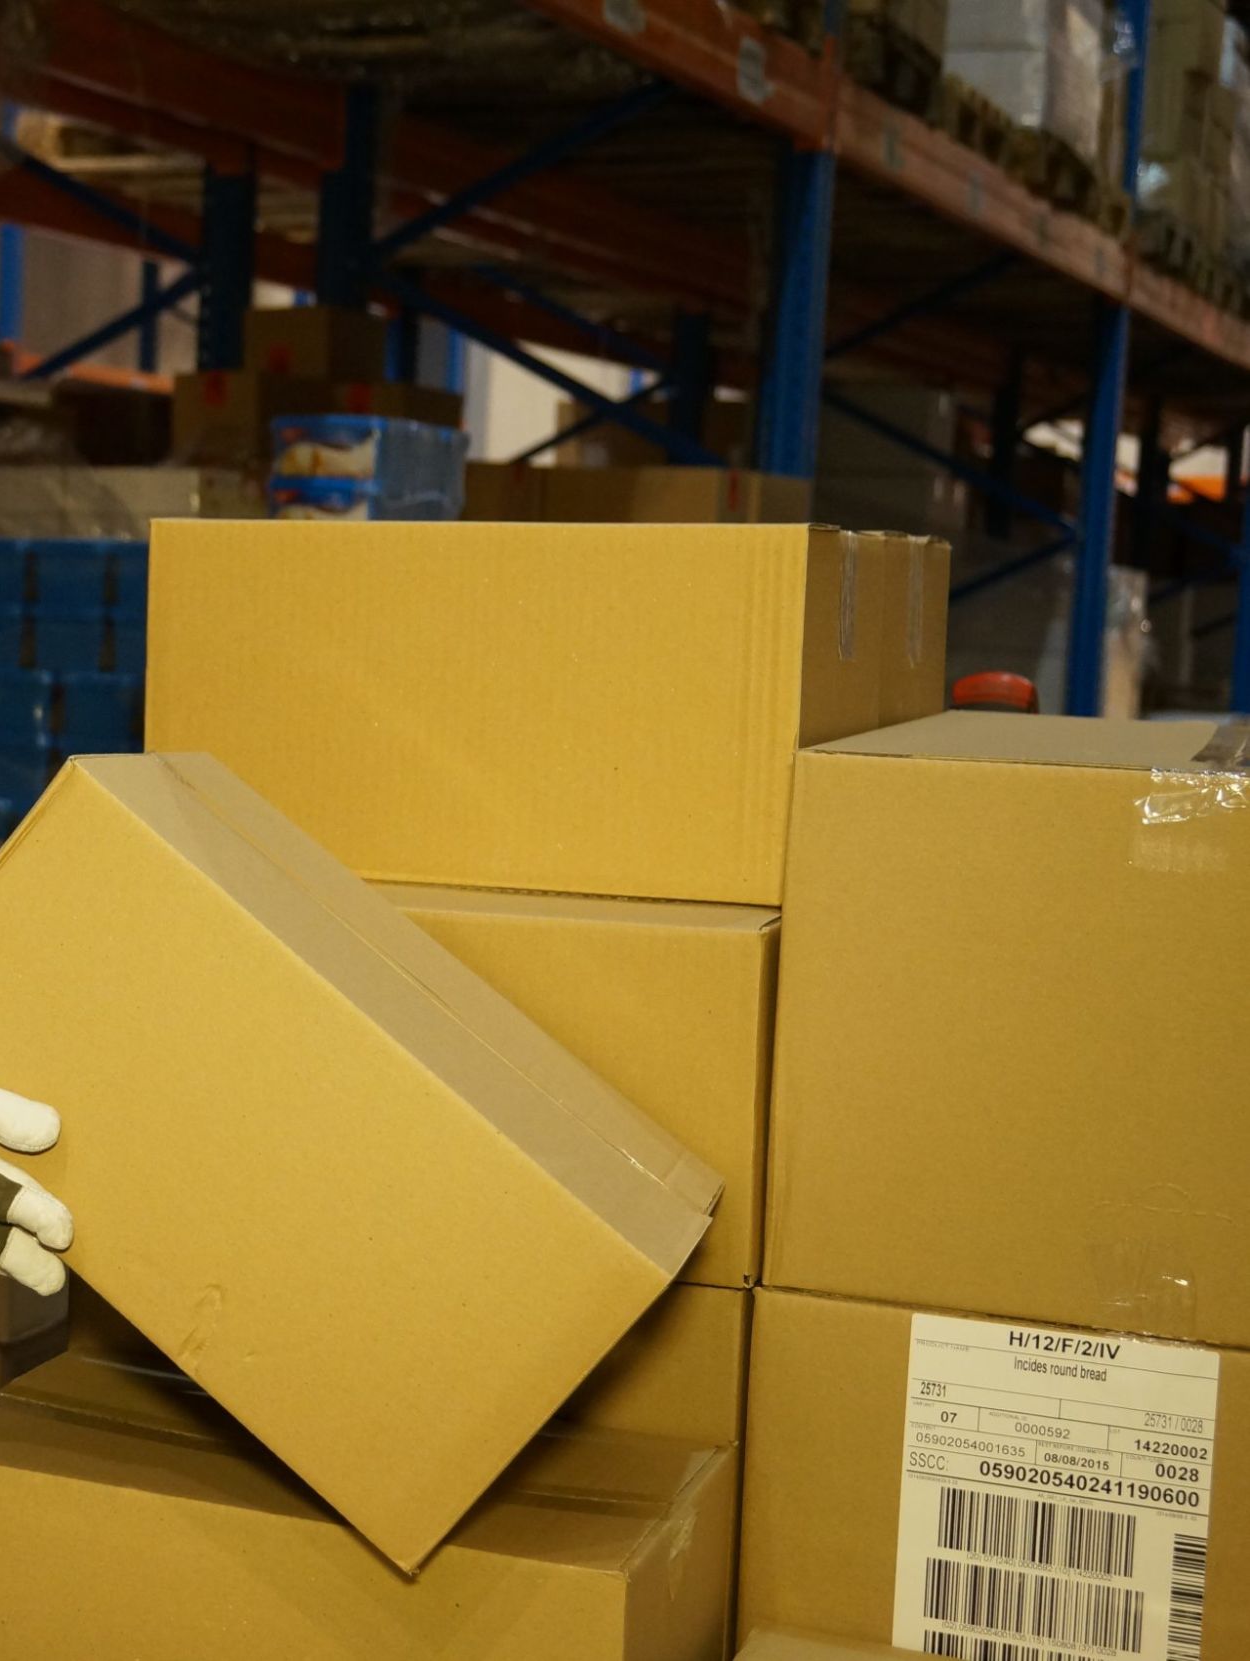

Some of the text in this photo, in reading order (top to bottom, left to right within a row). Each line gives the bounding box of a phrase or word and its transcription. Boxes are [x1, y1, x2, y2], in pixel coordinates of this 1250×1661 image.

[1009, 1331, 1120, 1359] H/12/F/2/IV
[1014, 1356, 1107, 1382] Incides round bread
[920, 1381, 947, 1398] 25731
[940, 1411, 957, 1423] 07
[1014, 1422, 1071, 1439] 0000592
[916, 1432, 1026, 1457] 05902054001635
[1134, 1439, 1208, 1460] 14220002
[1044, 1453, 1110, 1470] 08/08/2015
[1155, 1463, 1199, 1482] 0028
[979, 1460, 1200, 1507] 059020540241190600
